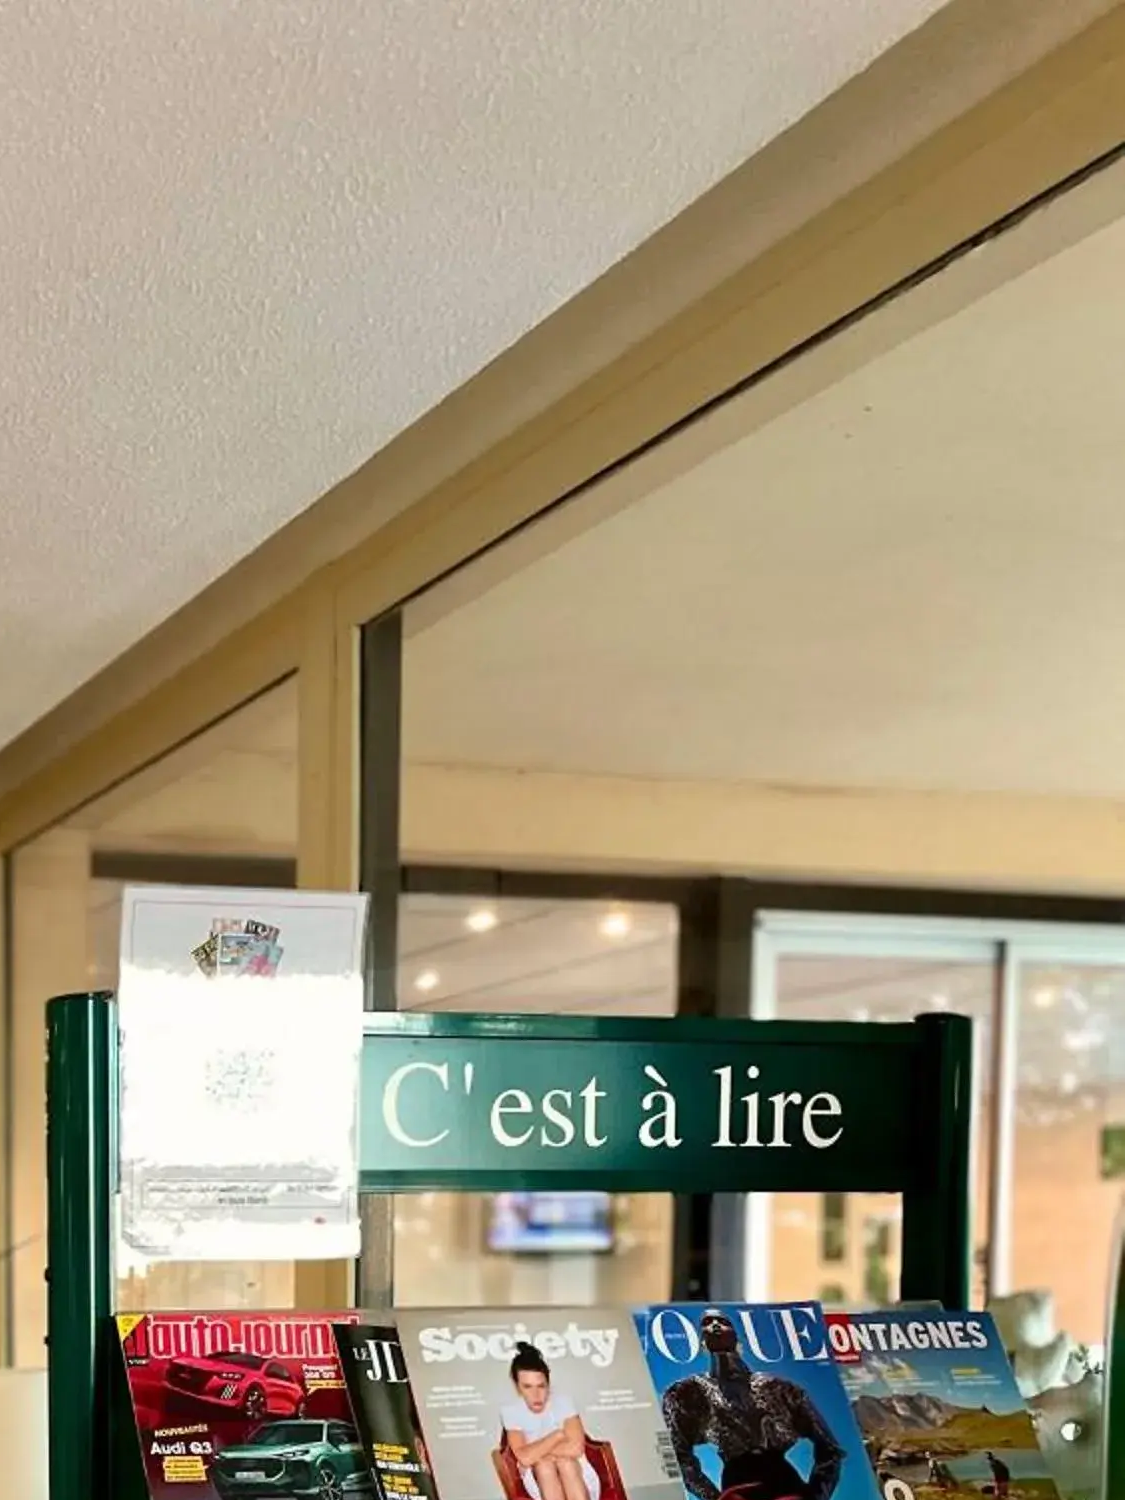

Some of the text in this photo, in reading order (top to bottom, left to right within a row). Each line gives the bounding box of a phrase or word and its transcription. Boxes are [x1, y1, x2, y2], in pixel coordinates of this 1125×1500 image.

[383, 1062, 845, 1148] C'est à lire
[418, 1323, 620, 1368] Society
[651, 1308, 830, 1365] OUE
[828, 1320, 989, 1353] ONTAGNES
[150, 1441, 213, 1455] Audi Q3
